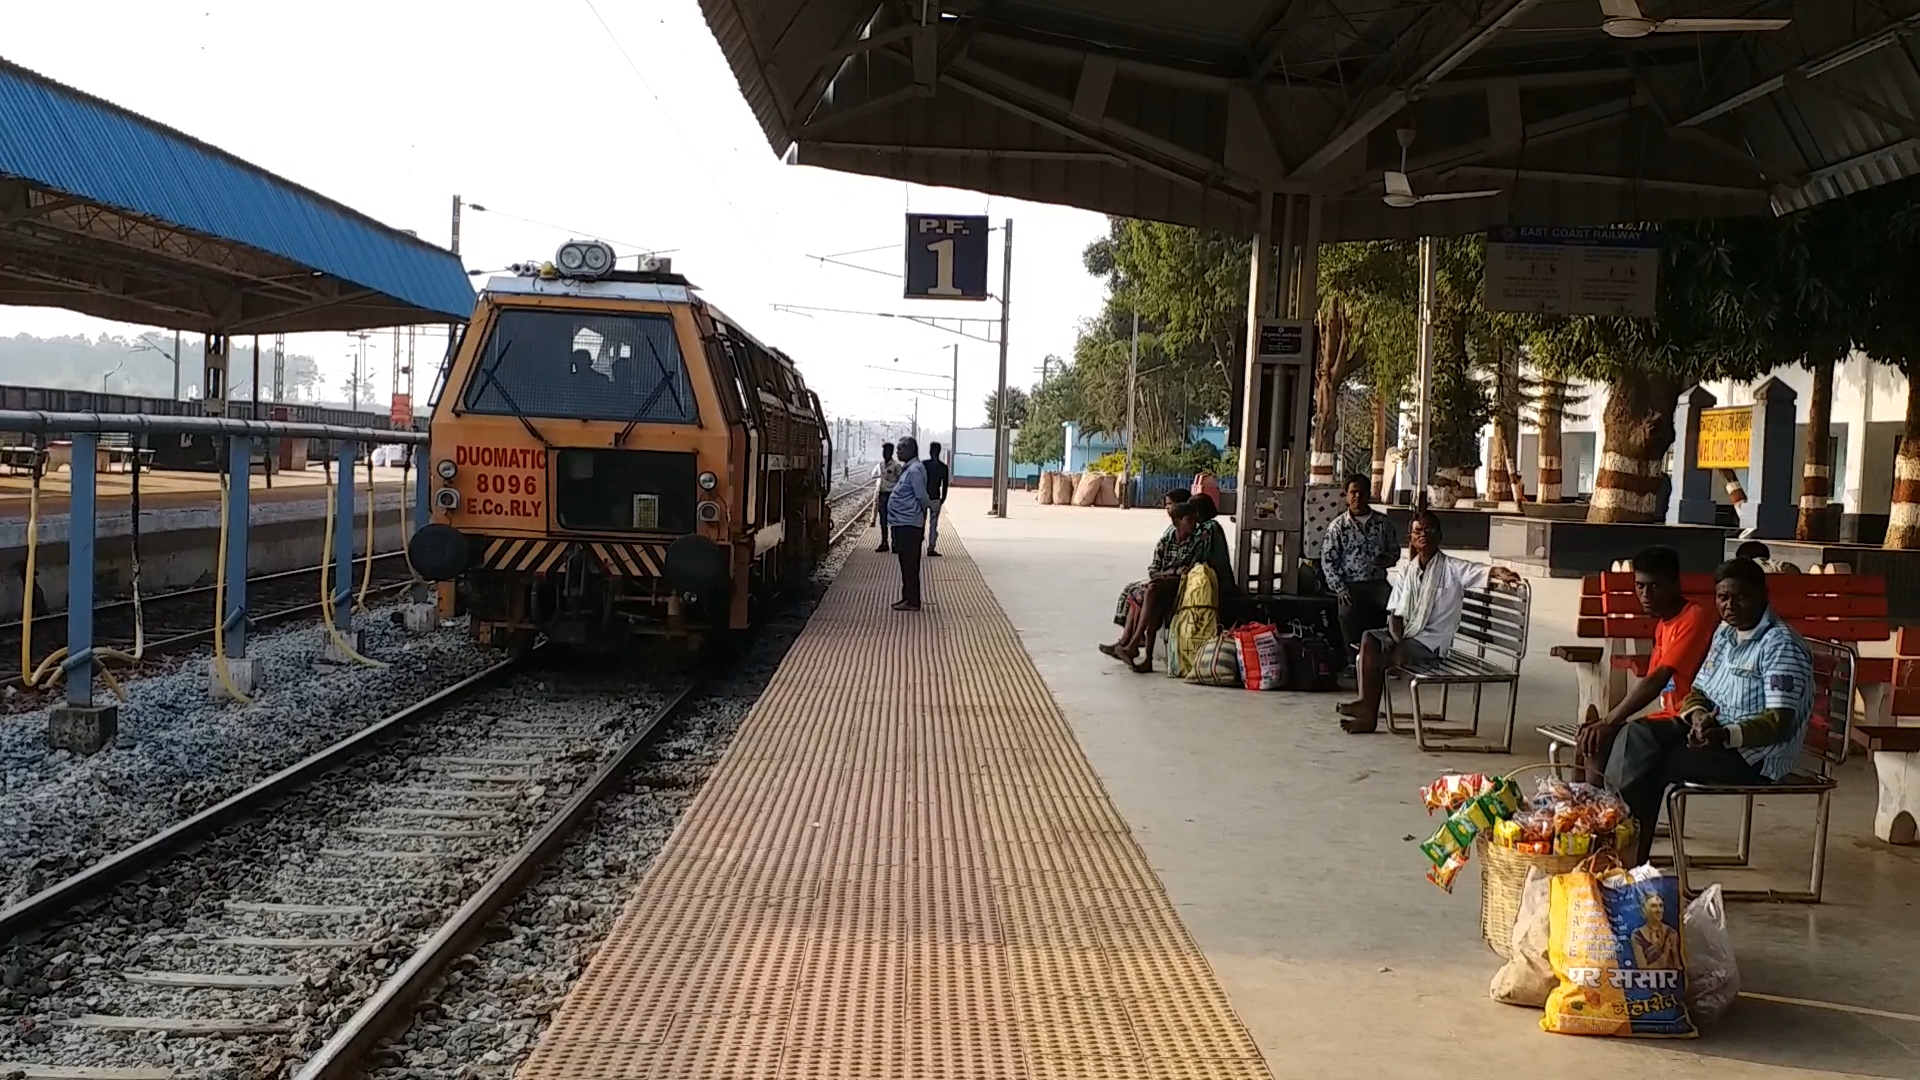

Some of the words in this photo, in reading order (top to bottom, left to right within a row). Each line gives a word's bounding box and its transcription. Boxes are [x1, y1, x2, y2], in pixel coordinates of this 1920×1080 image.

[919, 218, 970, 235] P.F.
[1520, 227, 1549, 238] EAST
[1552, 228, 1589, 239] COAST
[1593, 229, 1642, 241] RAILWAY
[926, 238, 962, 295] 1
[456, 445, 546, 470] DUOMATIC
[476, 473, 537, 496] 8096
[467, 498, 542, 518] E.Co.RLY
[1607, 959, 1678, 989] संसार
